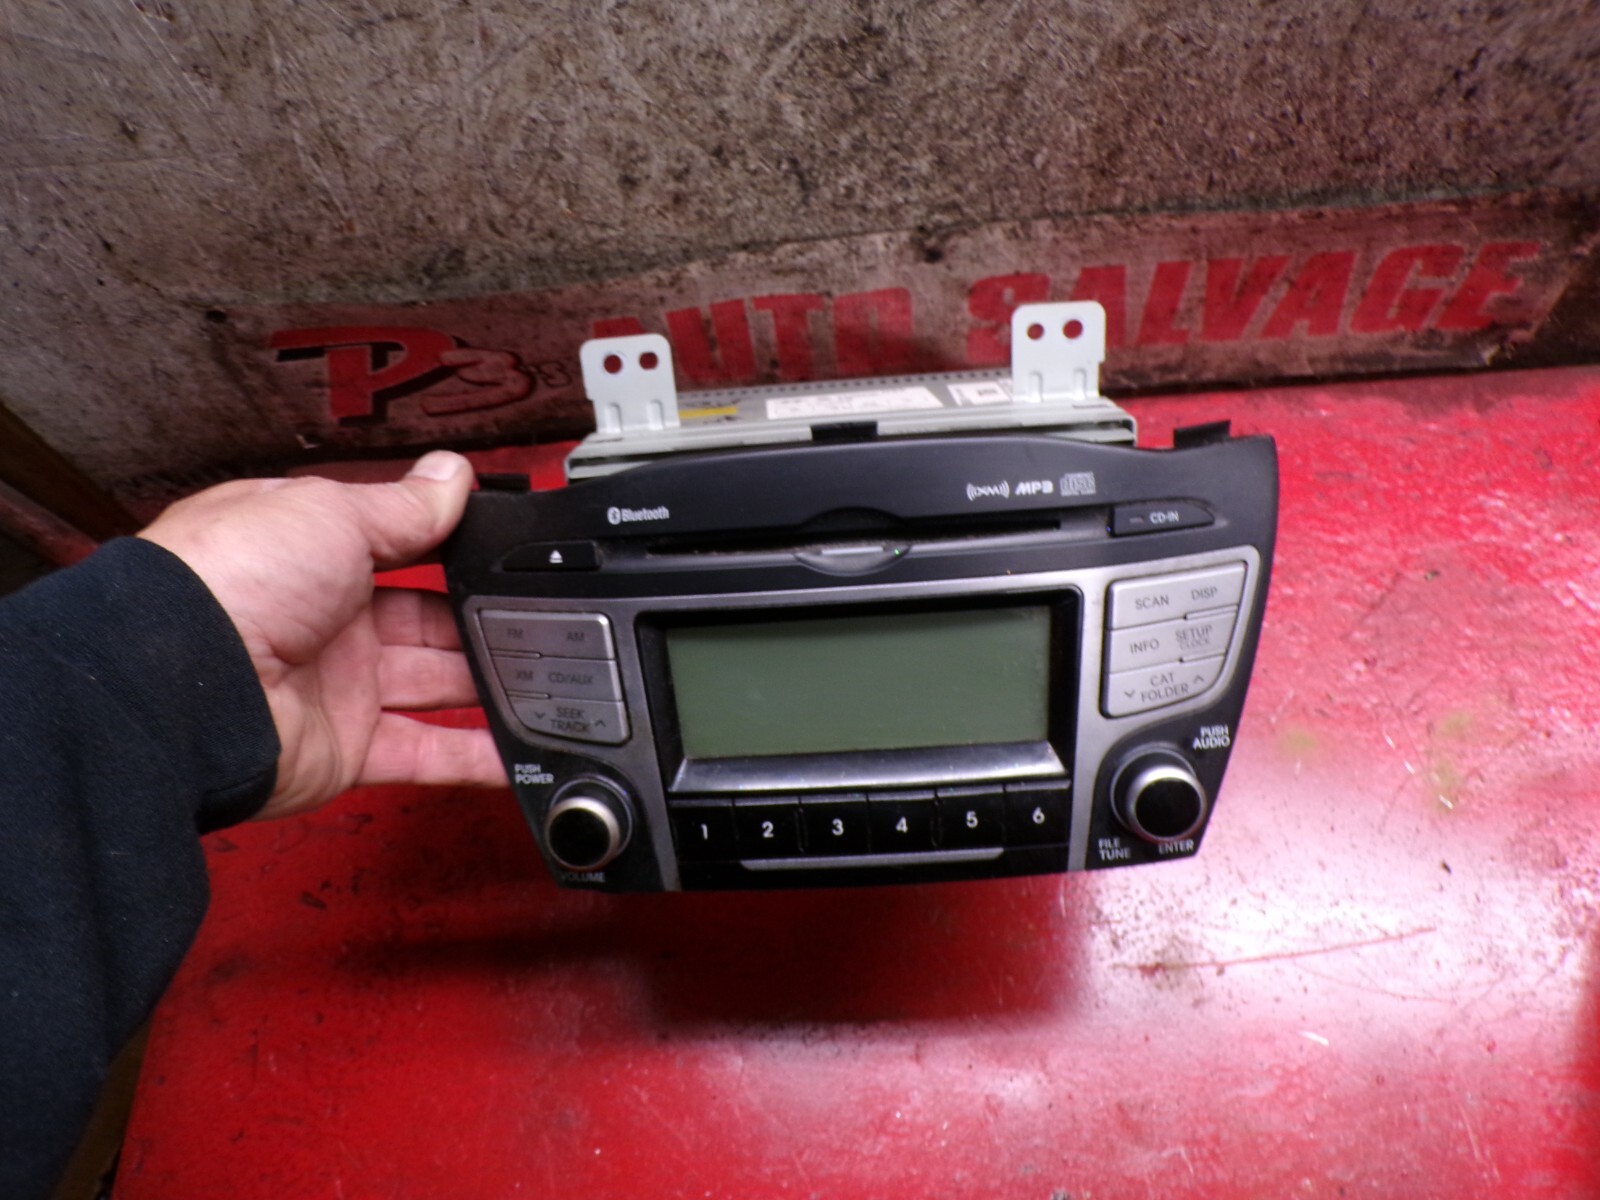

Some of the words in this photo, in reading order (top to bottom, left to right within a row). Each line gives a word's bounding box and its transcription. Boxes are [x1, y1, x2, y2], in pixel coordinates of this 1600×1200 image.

[592, 287, 912, 383] UTO
[965, 241, 1542, 364] SALVAGE
[1015, 480, 1054, 496] MP3
[620, 506, 670, 523] Bluetooth
[1135, 594, 1170, 611] SCAN
[1191, 586, 1218, 601] DISP
[507, 628, 524, 639] FM
[566, 632, 585, 641] AM
[1175, 625, 1213, 642] SETUP
[1129, 639, 1160, 654] INFO
[516, 671, 534, 681] XM
[547, 672, 595, 685] CD/AUX
[1150, 672, 1176, 687] CAT
[1140, 683, 1190, 703] FOLDER
[556, 706, 585, 718] SEEK
[551, 719, 591, 733] TRACK
[1200, 725, 1229, 737] PUSH
[1192, 737, 1231, 750] AUDIO
[514, 763, 541, 774] PUSH
[515, 773, 555, 785] POWER
[700, 824, 709, 840] 1
[761, 821, 775, 838] 2
[831, 818, 844, 836] 3
[896, 816, 909, 834] 4
[965, 811, 979, 828] 5
[1032, 807, 1045, 825] 6
[1158, 840, 1195, 855] ENTER
[1100, 848, 1131, 862] TUNE
[561, 871, 605, 883] VOLUME
